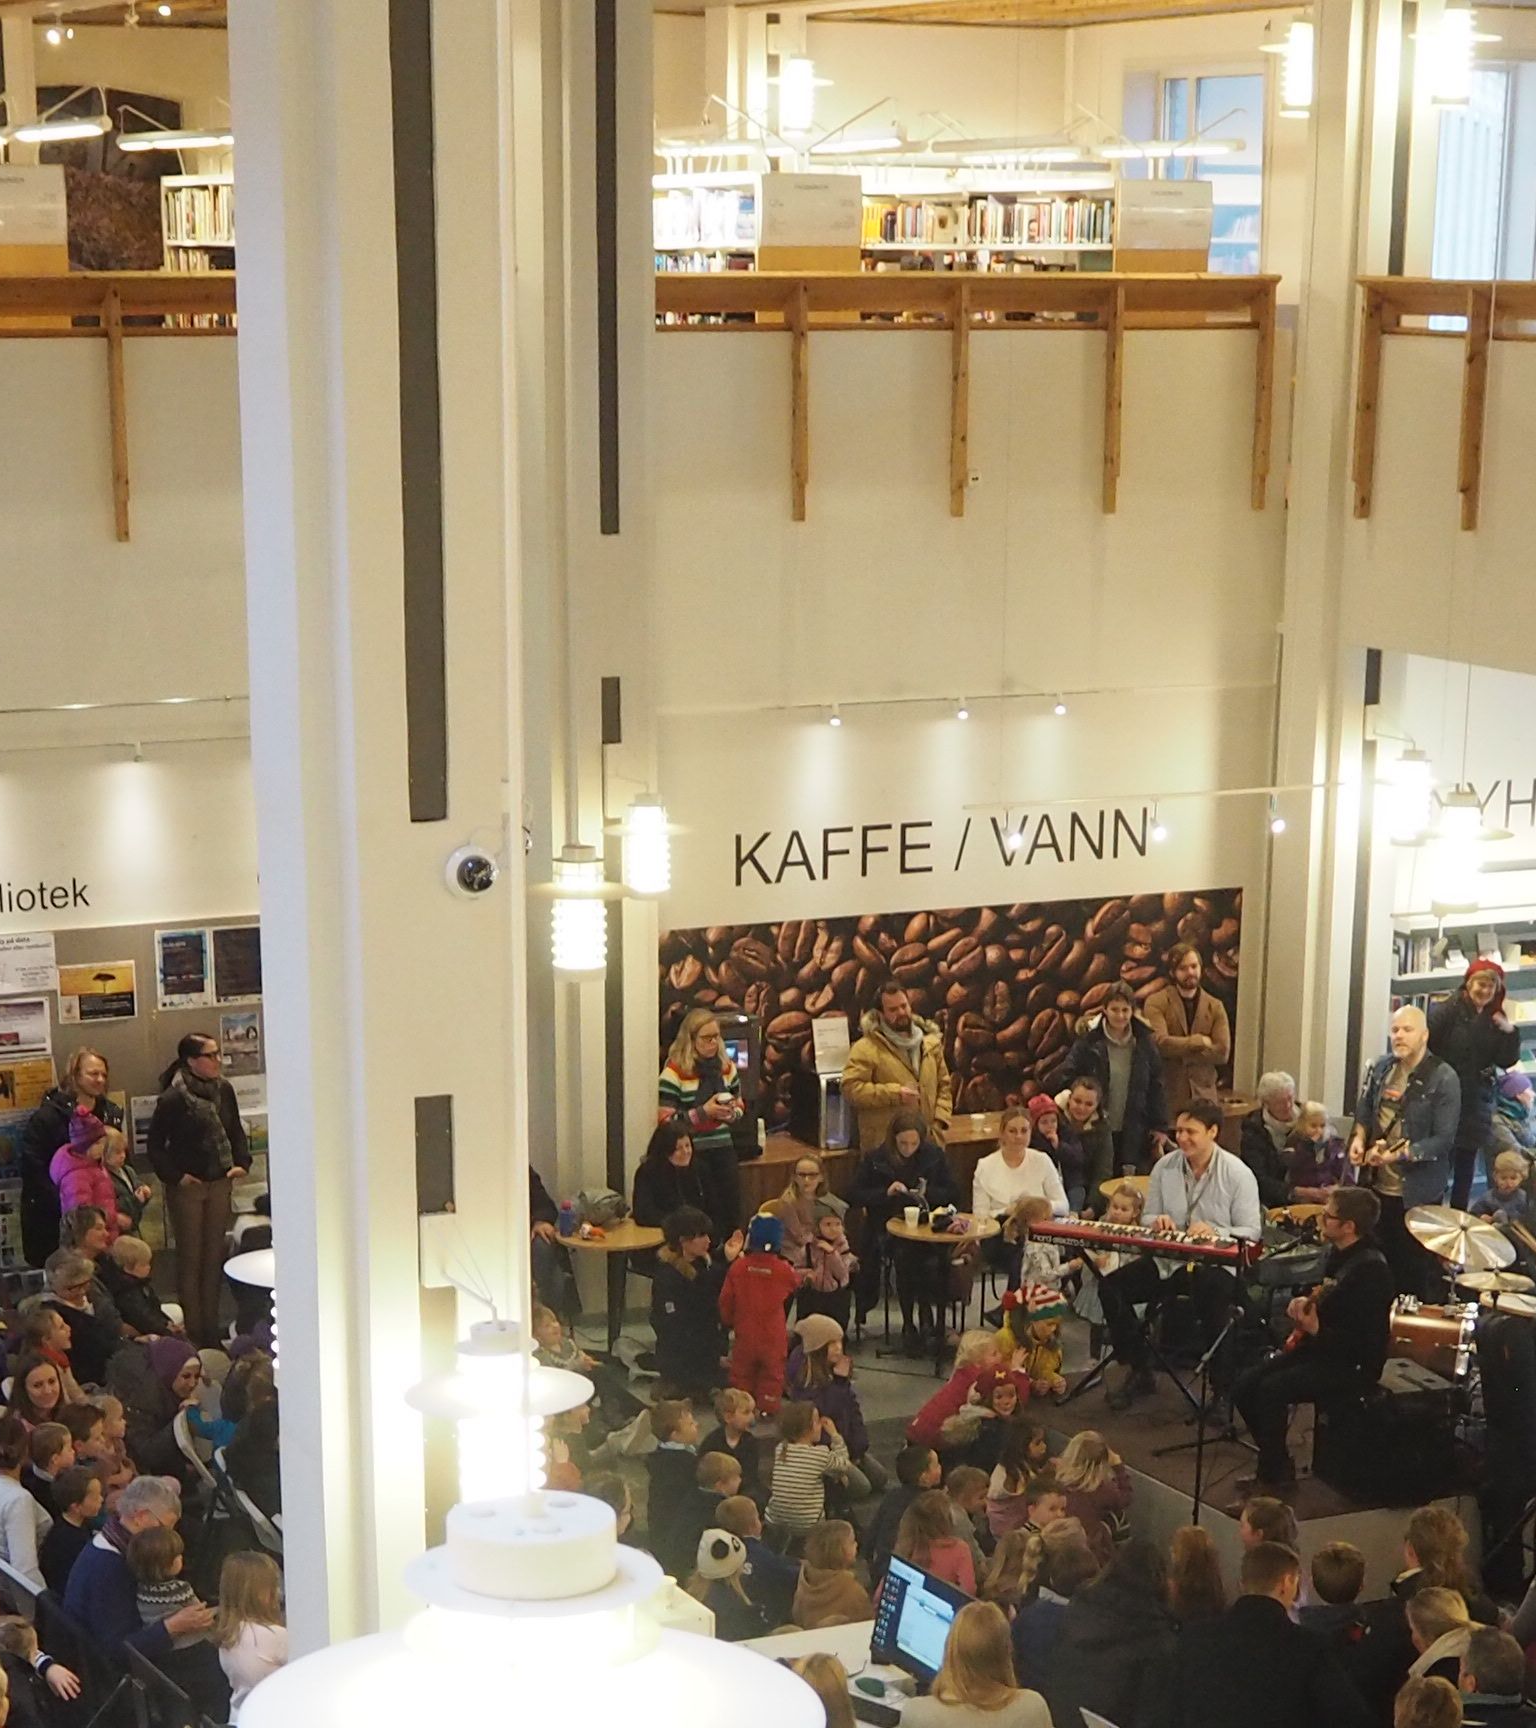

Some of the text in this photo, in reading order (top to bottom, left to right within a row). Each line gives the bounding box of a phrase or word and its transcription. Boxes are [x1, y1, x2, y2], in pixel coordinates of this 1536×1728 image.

[734, 807, 1148, 887] KAFFE / VANN
